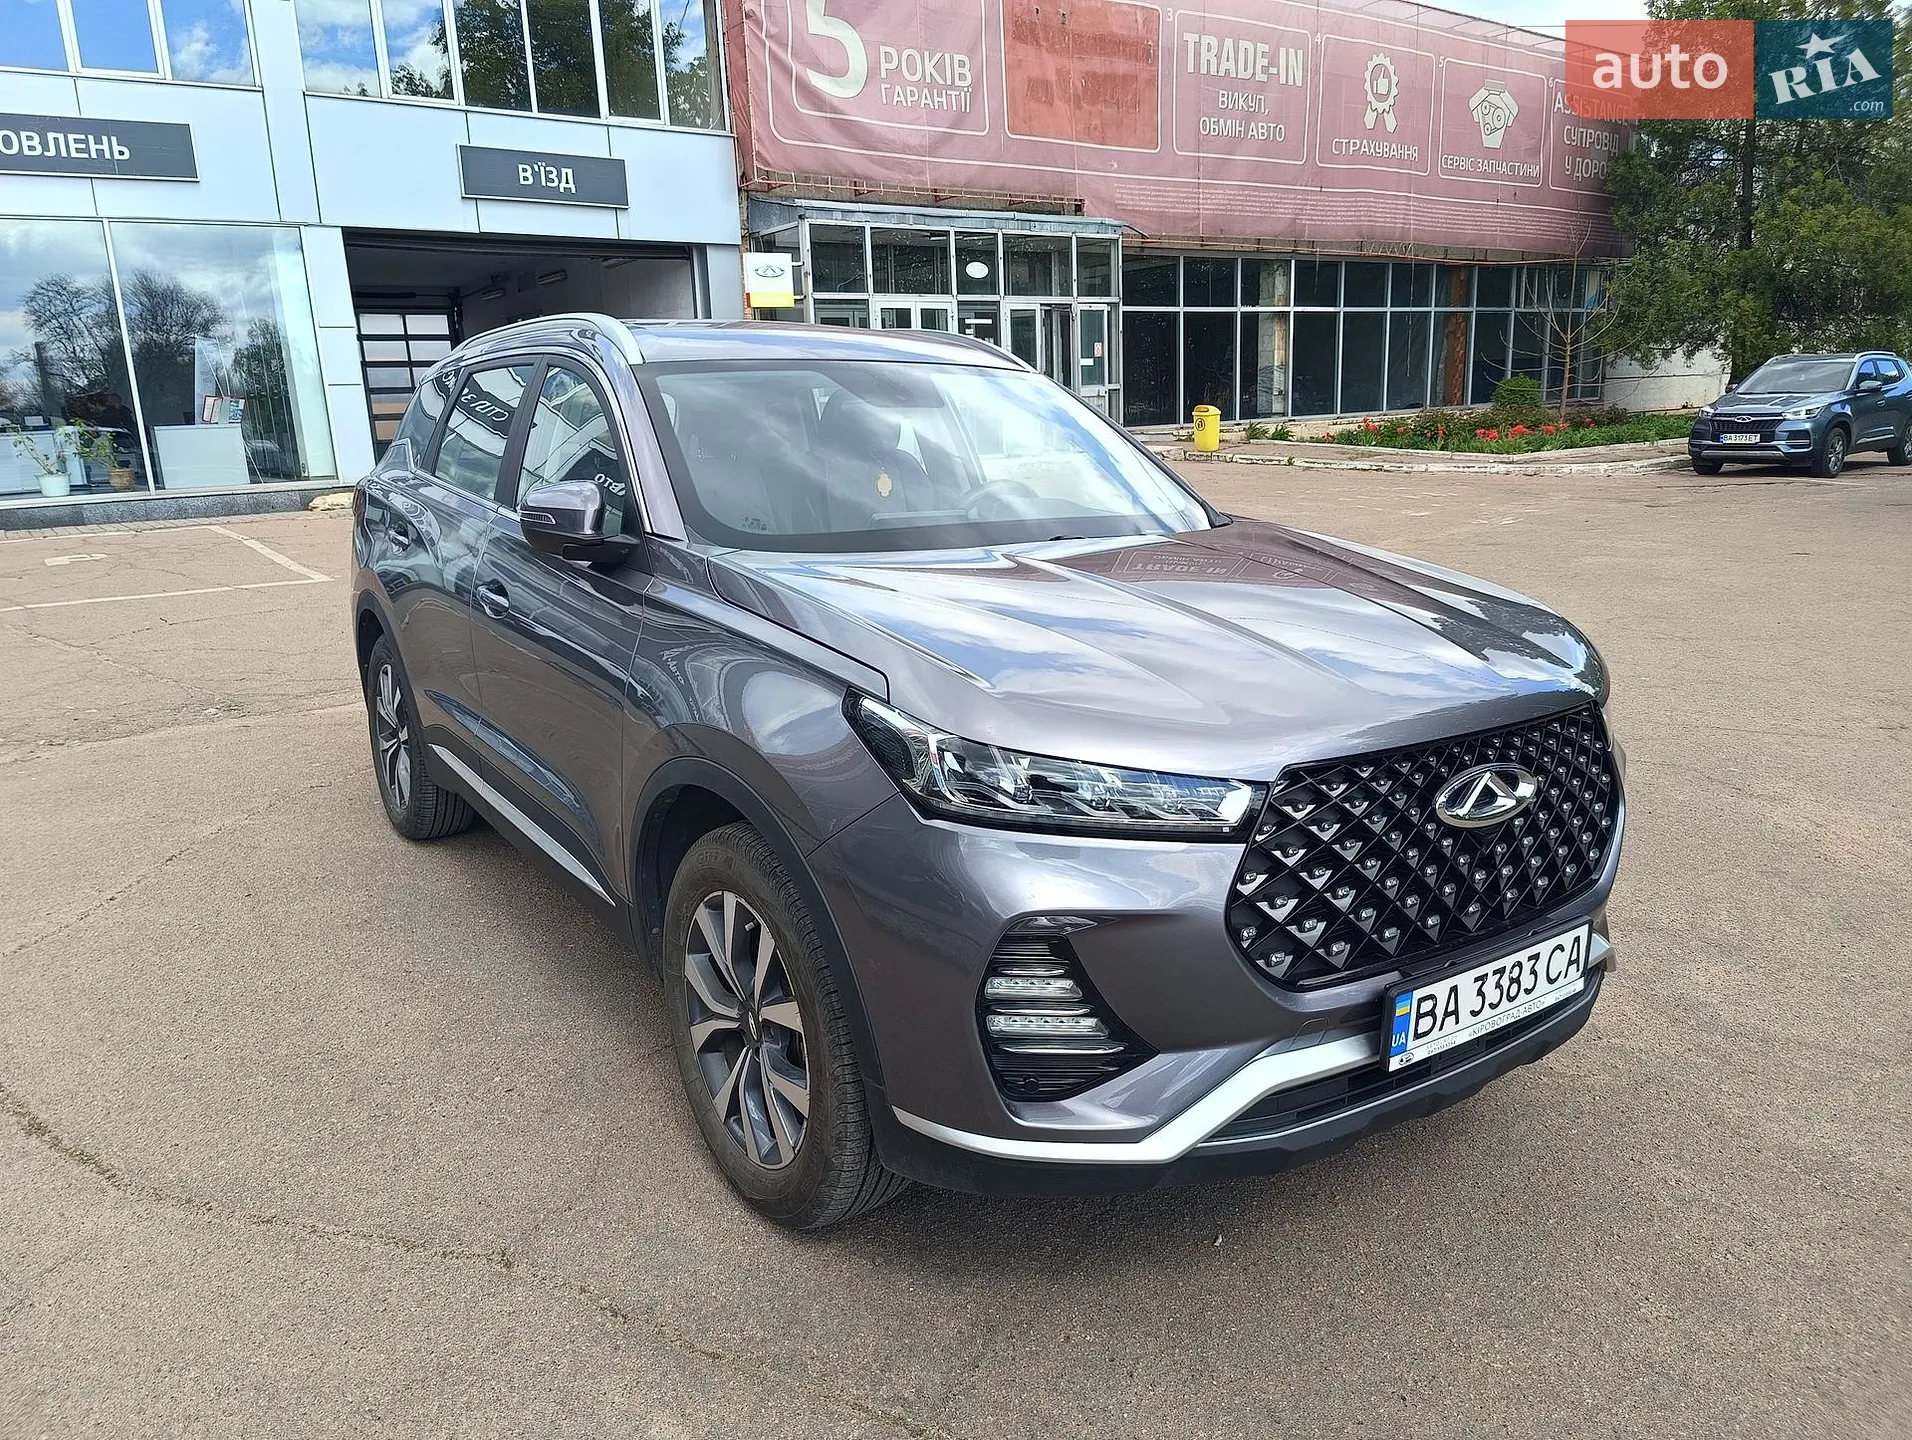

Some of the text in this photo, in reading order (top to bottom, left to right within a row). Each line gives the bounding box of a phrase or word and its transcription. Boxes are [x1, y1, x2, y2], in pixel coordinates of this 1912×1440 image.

[1166, 8, 1173, 22] 3
[806, 0, 973, 99] 5 РОКІВ
[1314, 32, 1321, 46] 4
[1183, 32, 1304, 87] TRADE-IN
[880, 84, 972, 113] ГАРАНТІЇ
[1218, 90, 1269, 116] ВИКУП,
[1200, 117, 1285, 142] ОБМІН АВТО
[1563, 125, 1619, 157] СУПРОВІД
[0, 129, 131, 161] ОВЛЕНЬ
[1332, 138, 1419, 162] СТРАХУВАННЯ
[1442, 154, 1540, 179] СЕРВІС ЗАПЧАСТИНИ
[1565, 155, 1607, 182] У ДОРО
[1413, 935, 1581, 1041] BA 3383 CA
[1391, 1031, 1406, 1047] UA
